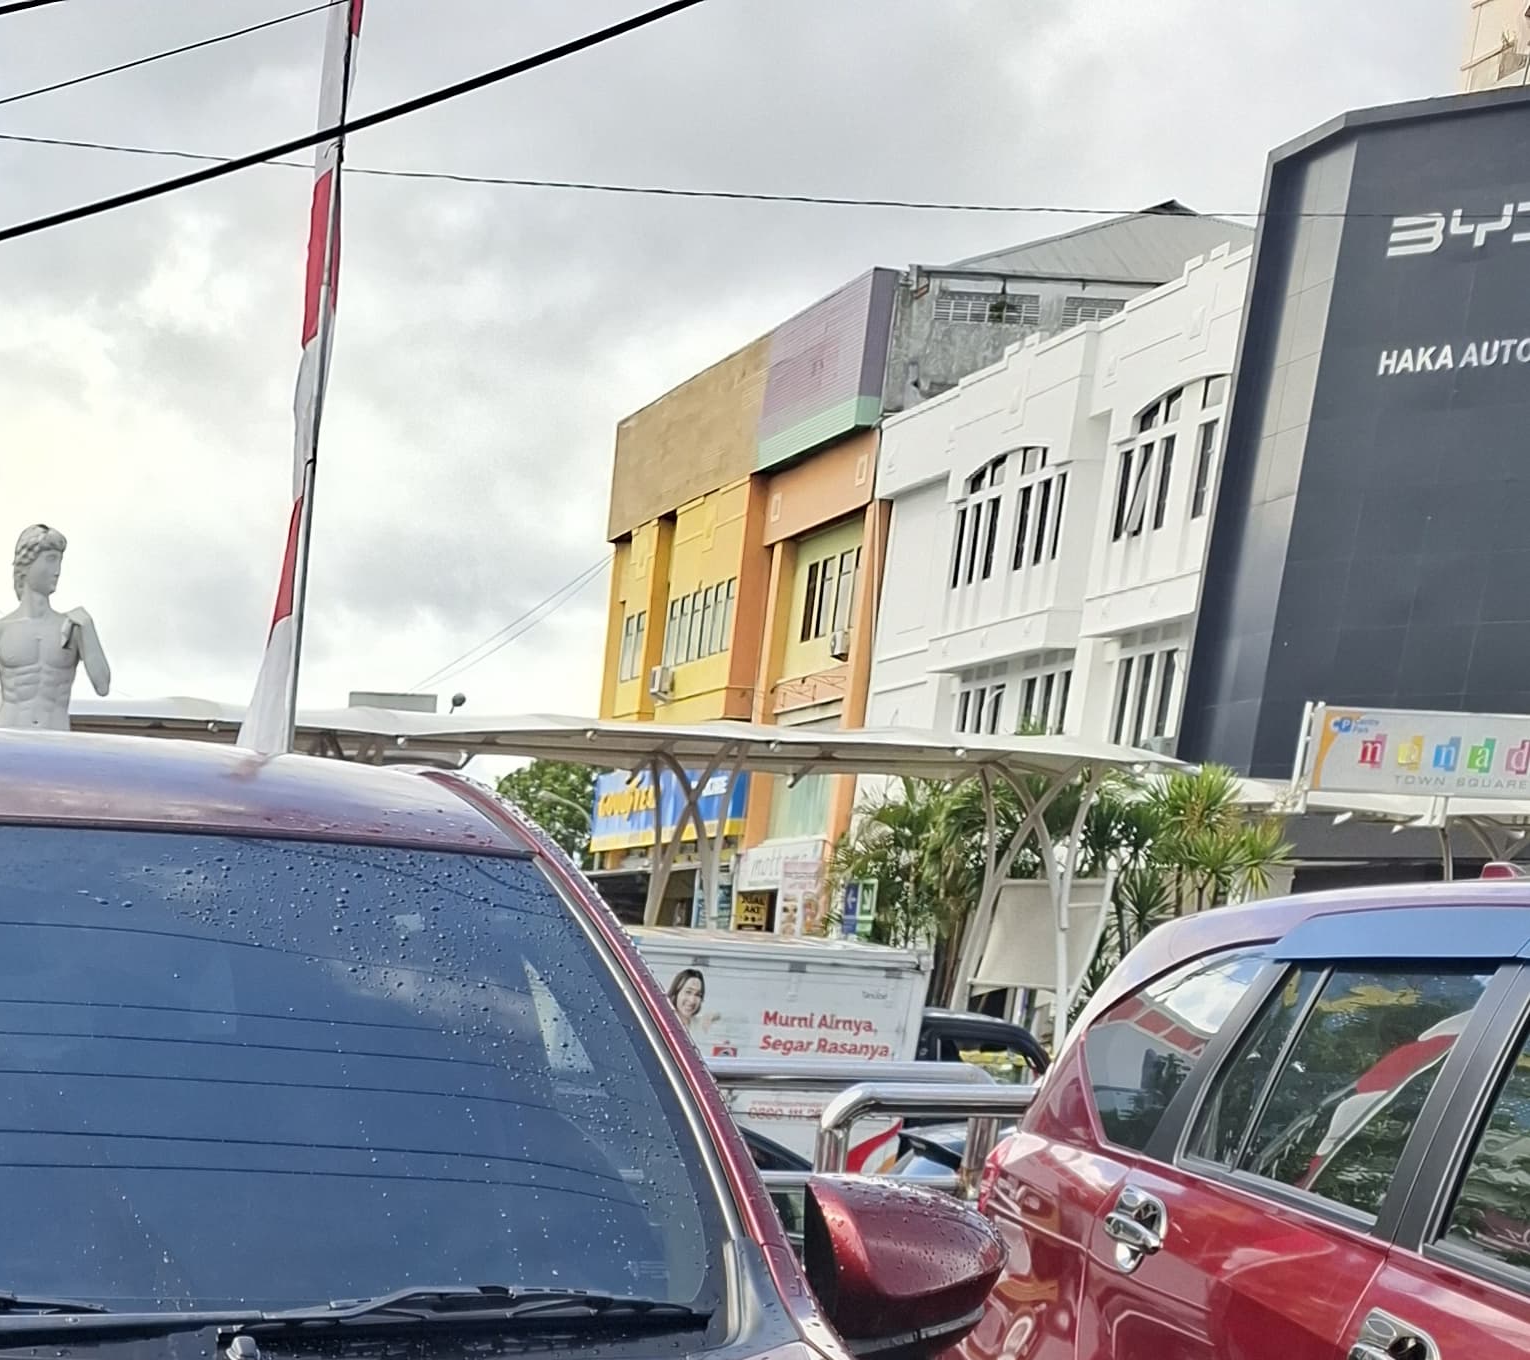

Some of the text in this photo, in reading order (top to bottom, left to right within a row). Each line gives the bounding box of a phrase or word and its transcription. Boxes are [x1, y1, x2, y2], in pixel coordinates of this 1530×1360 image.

[1386, 203, 1530, 258] BY
[1377, 344, 1454, 376] HAKA
[1393, 774, 1528, 790] TOWN SQUARE
[763, 1010, 815, 1030] Murni
[758, 1035, 813, 1056] Segar
